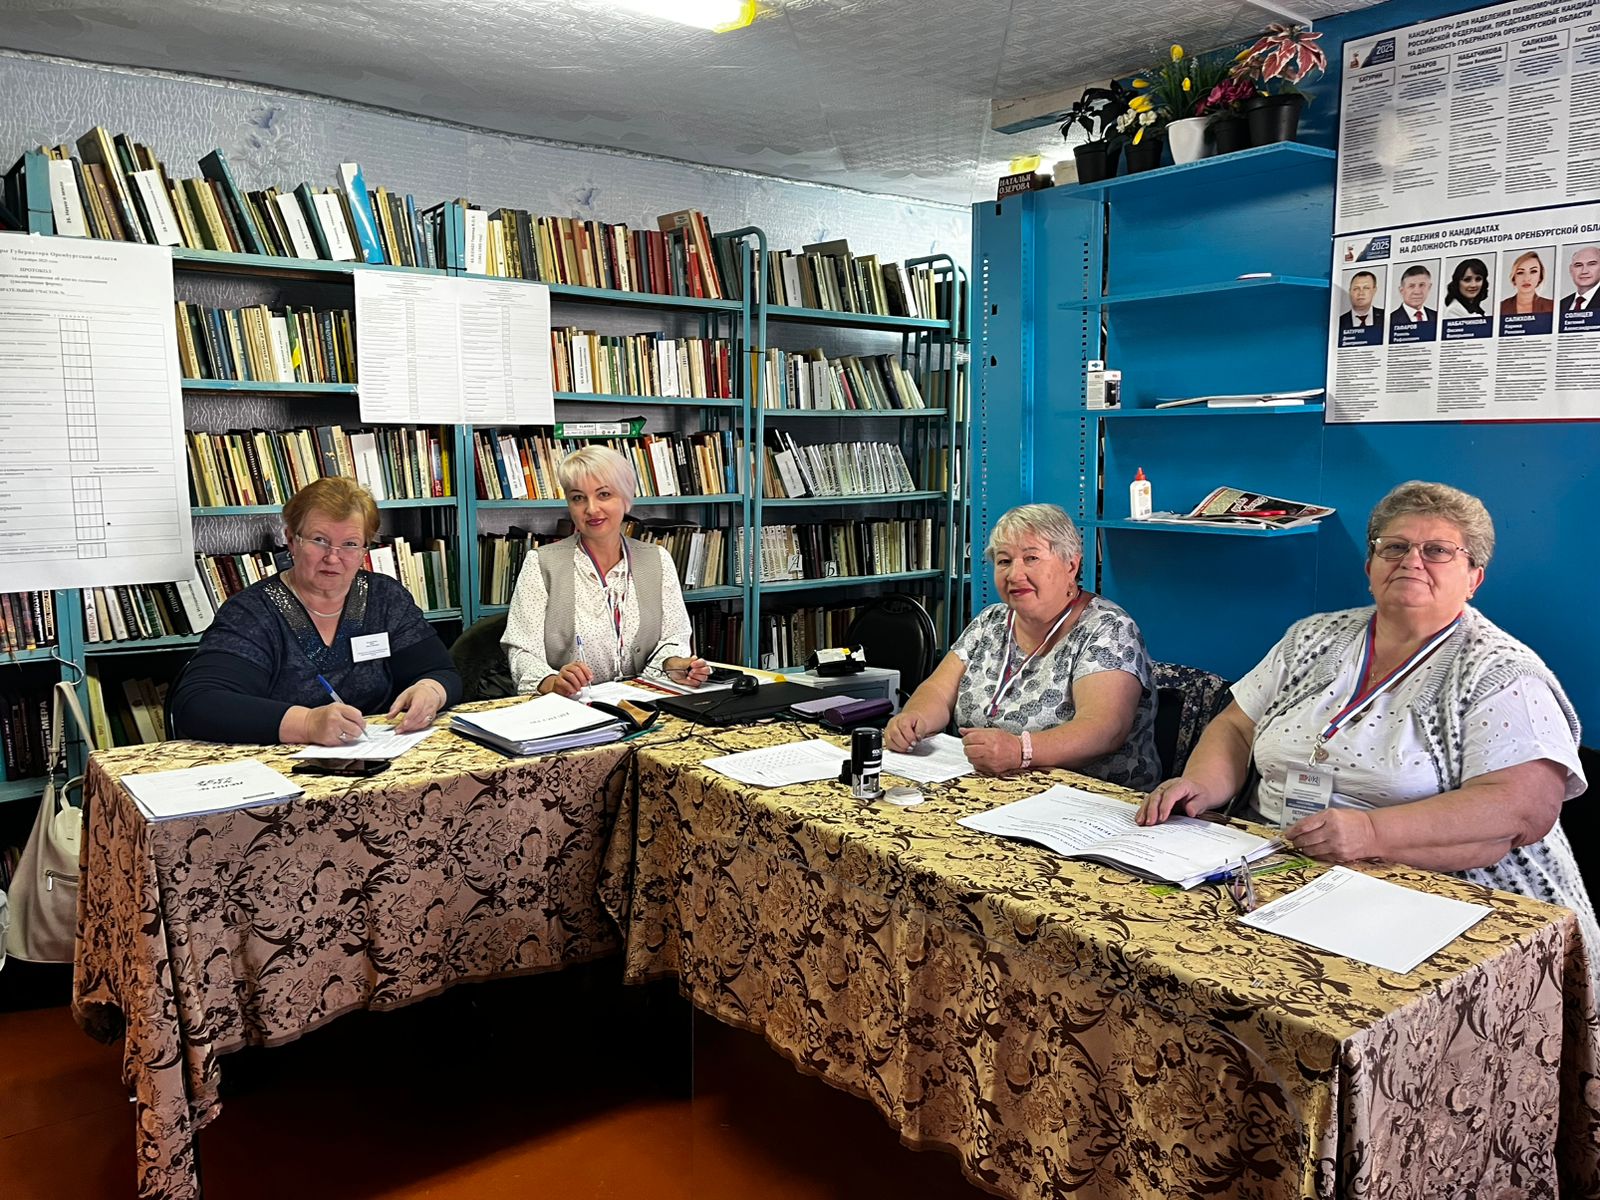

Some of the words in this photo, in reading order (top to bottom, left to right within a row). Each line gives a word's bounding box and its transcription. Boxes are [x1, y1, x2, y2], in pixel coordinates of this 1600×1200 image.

[1408, 32, 1450, 48] РОССИЙСКОЙ
[1417, 41, 1456, 56] ДОЛЖНОСТЬ
[1457, 31, 1502, 46] ГУБЕРНАТОРА
[1503, 16, 1557, 35] ОРЕНБУРГСКОЙ
[1558, 10, 1592, 23] ОБЛАСТИ
[1376, 44, 1394, 55] 2025
[999, 182, 1030, 194] ОЗЕРОВА
[1399, 246, 1409, 254] НА
[1410, 240, 1458, 254] ДОЛЖНОСТЬ
[1460, 234, 1513, 247] ГУБЕРНАТОРА
[1515, 224, 1578, 240] ОРЕНБУРГСКОЙ
[1400, 231, 1439, 243] СВЕДЕНИЯ
[1442, 230, 1447, 238] О
[1449, 224, 1500, 237] КАНДИДАТАХ
[1371, 240, 1390, 251] 2025
[40, 700, 50, 730] МЕРА
